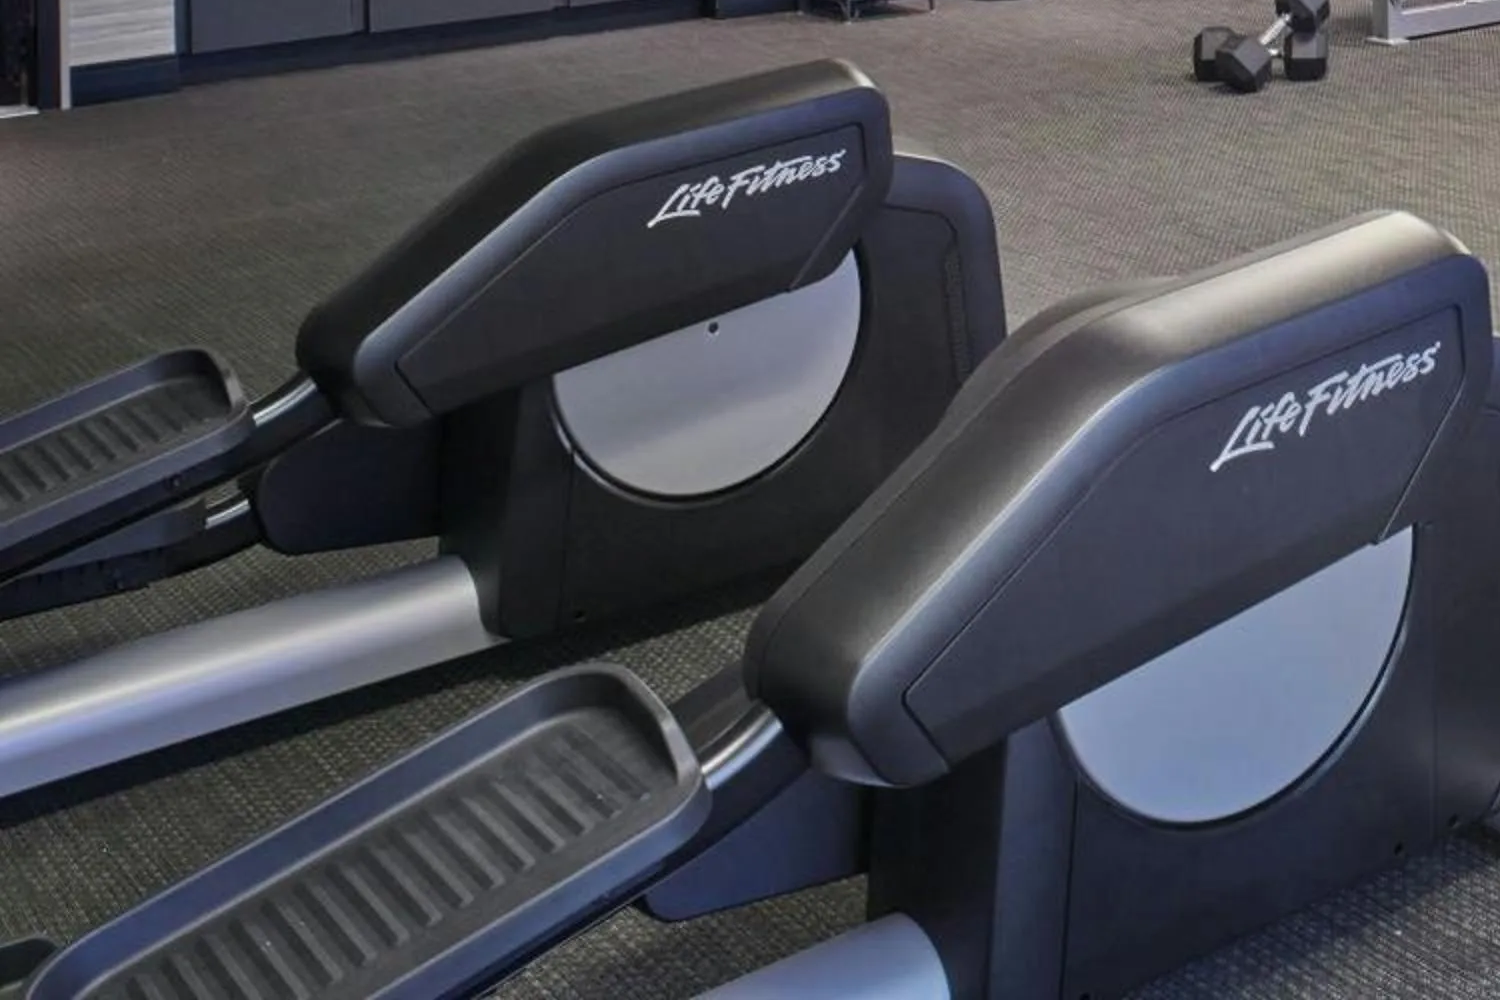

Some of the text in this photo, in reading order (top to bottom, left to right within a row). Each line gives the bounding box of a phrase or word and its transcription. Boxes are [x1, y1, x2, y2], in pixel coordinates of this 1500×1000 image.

[647, 149, 846, 228] Life Fitness
[1209, 341, 1441, 472] Life Fitness
